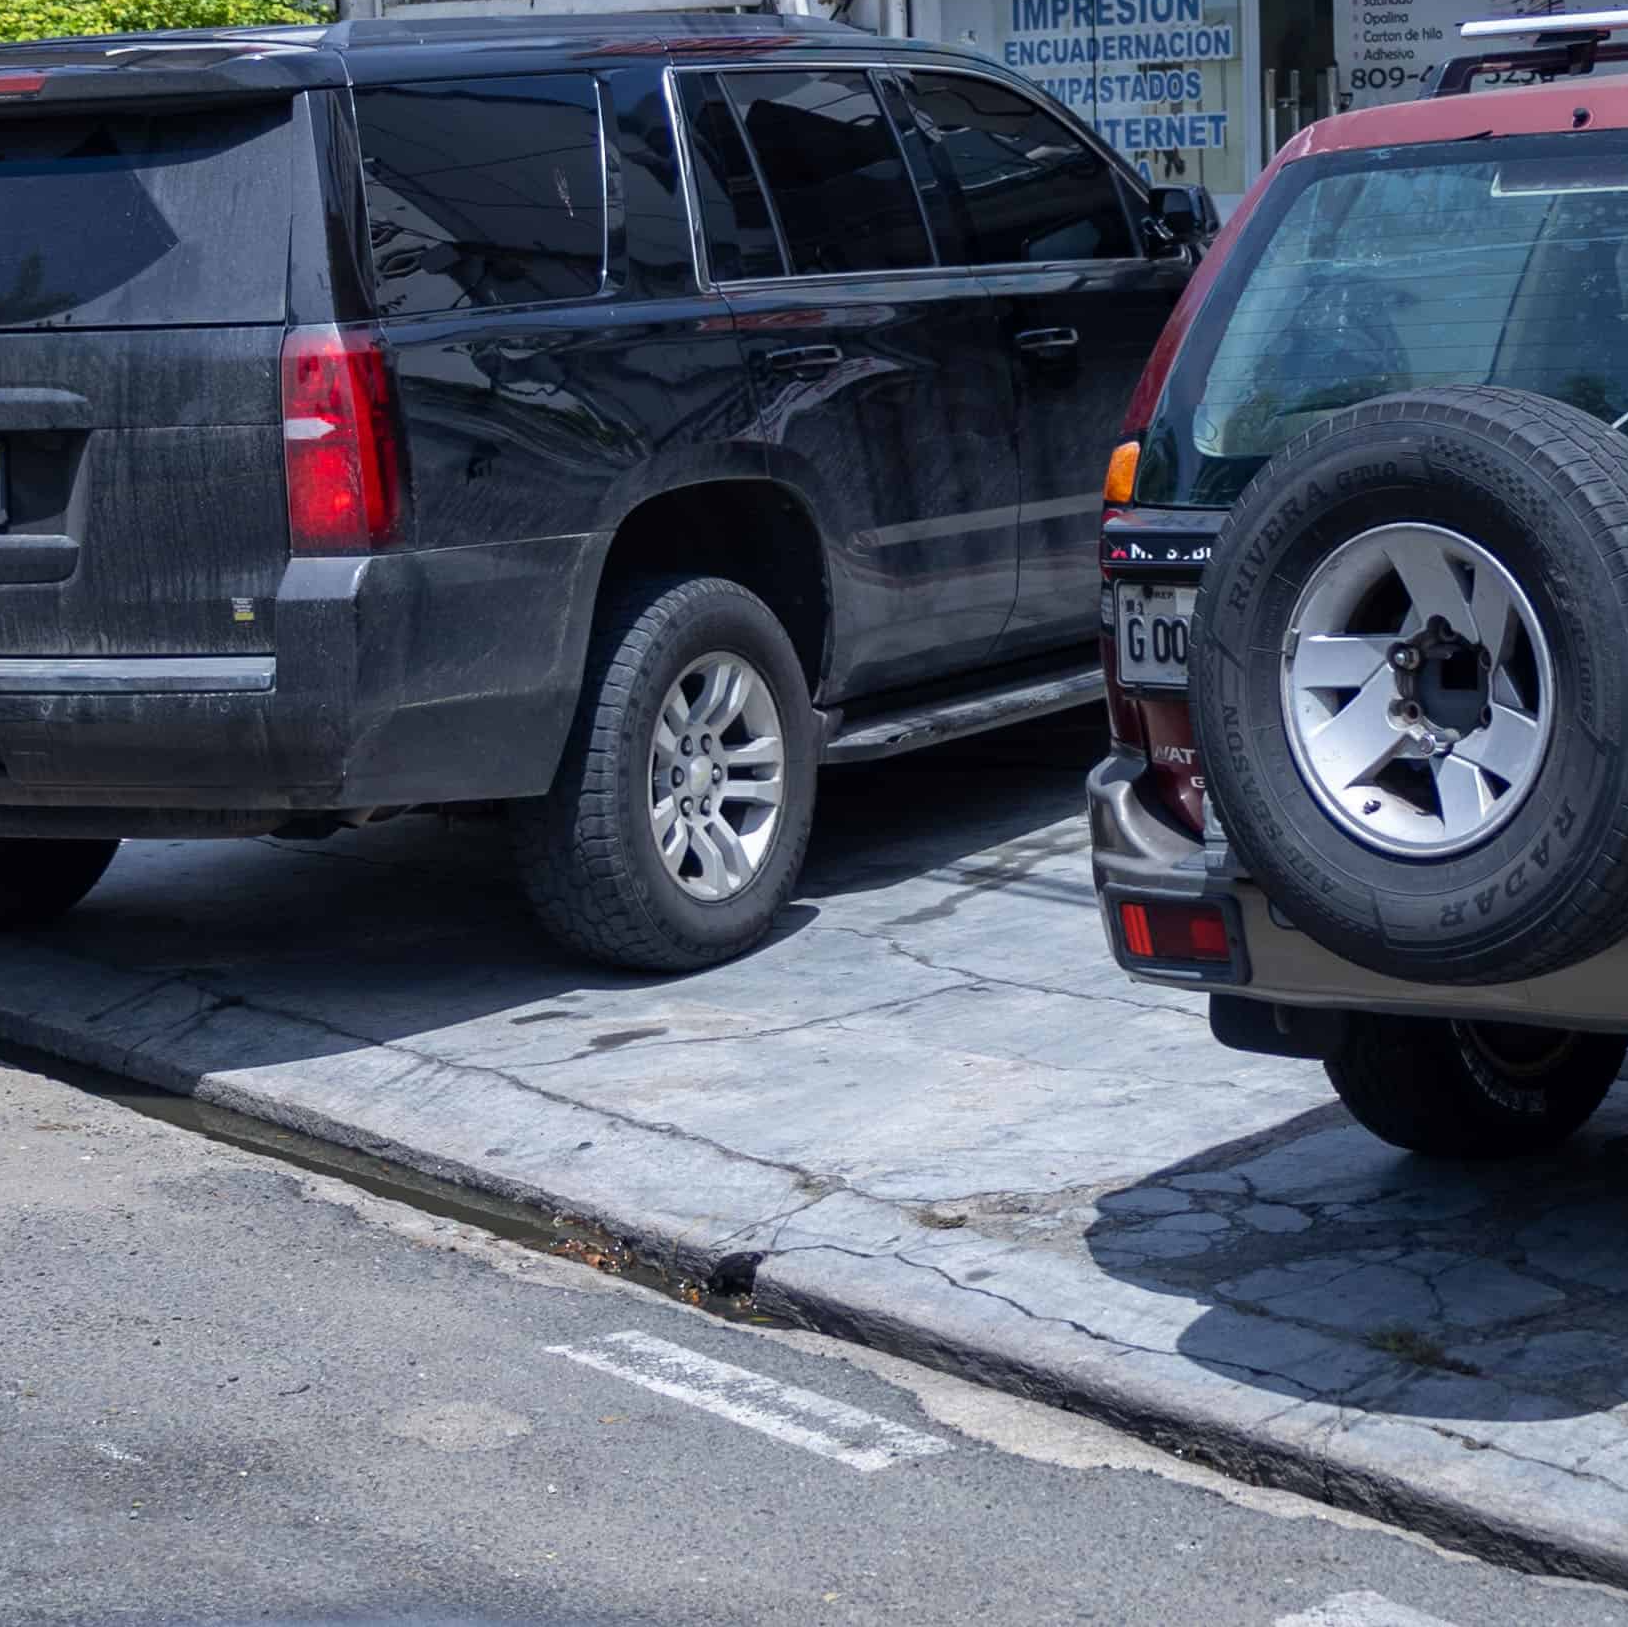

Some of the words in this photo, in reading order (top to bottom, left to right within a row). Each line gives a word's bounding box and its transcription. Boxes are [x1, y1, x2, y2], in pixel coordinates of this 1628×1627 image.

[1363, 11, 1409, 26] Opalina
[1363, 29, 1402, 43] Carton
[1406, 29, 1420, 42] de
[1422, 27, 1443, 41] hilo
[1004, 29, 1231, 66] ENCUADERNACION
[1363, 47, 1415, 61] Adhesivo
[1035, 71, 1202, 105] MPASTADOS
[1093, 114, 1228, 149] TERNET
[1227, 480, 1329, 613] RIVERA
[1439, 796, 1577, 929] RADAR
